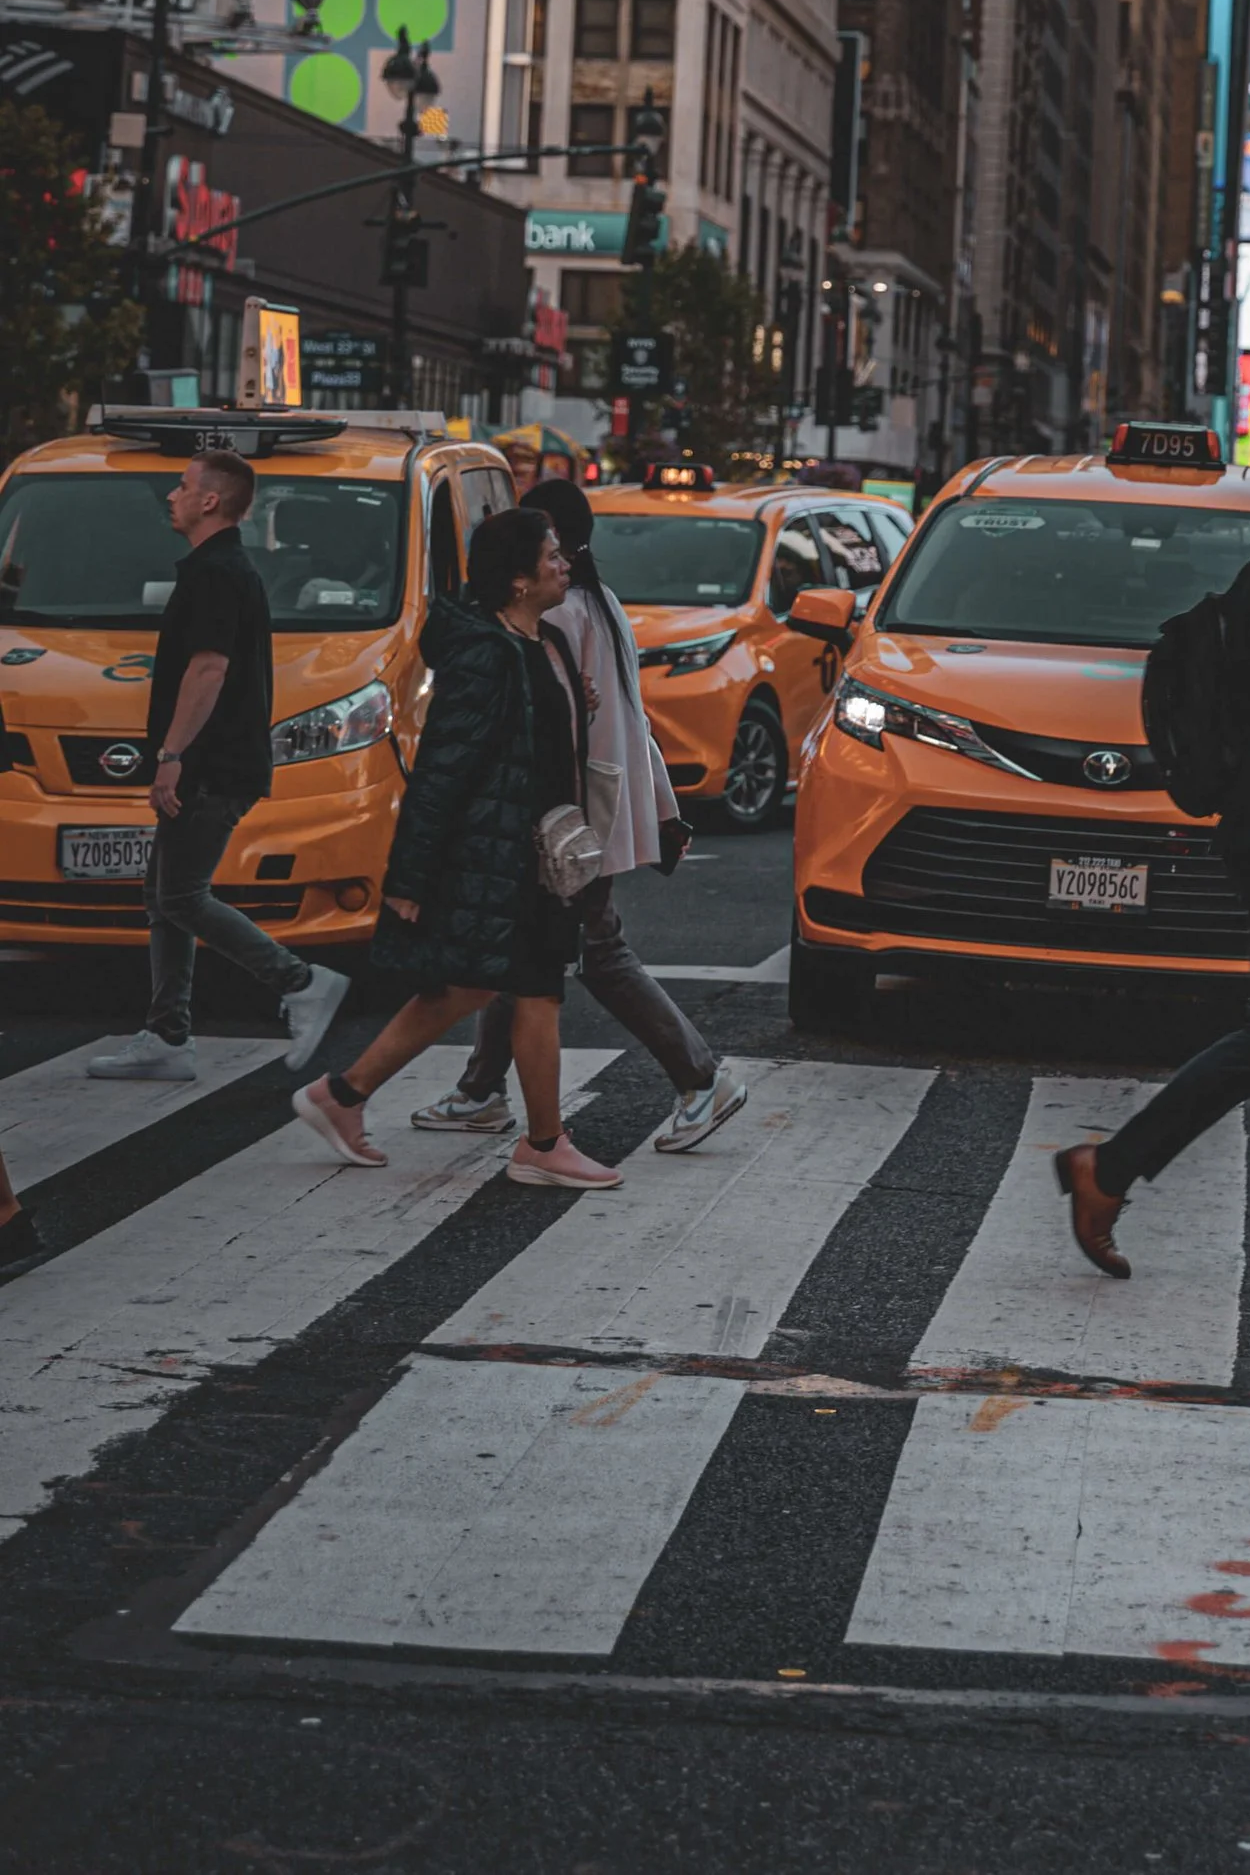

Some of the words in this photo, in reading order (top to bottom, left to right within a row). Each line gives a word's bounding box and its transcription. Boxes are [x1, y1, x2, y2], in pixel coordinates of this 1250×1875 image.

[525, 219, 595, 251] bank
[195, 431, 237, 452] 3E73
[1140, 432, 1195, 457] 7D95
[1056, 869, 1139, 900] Y209856C
